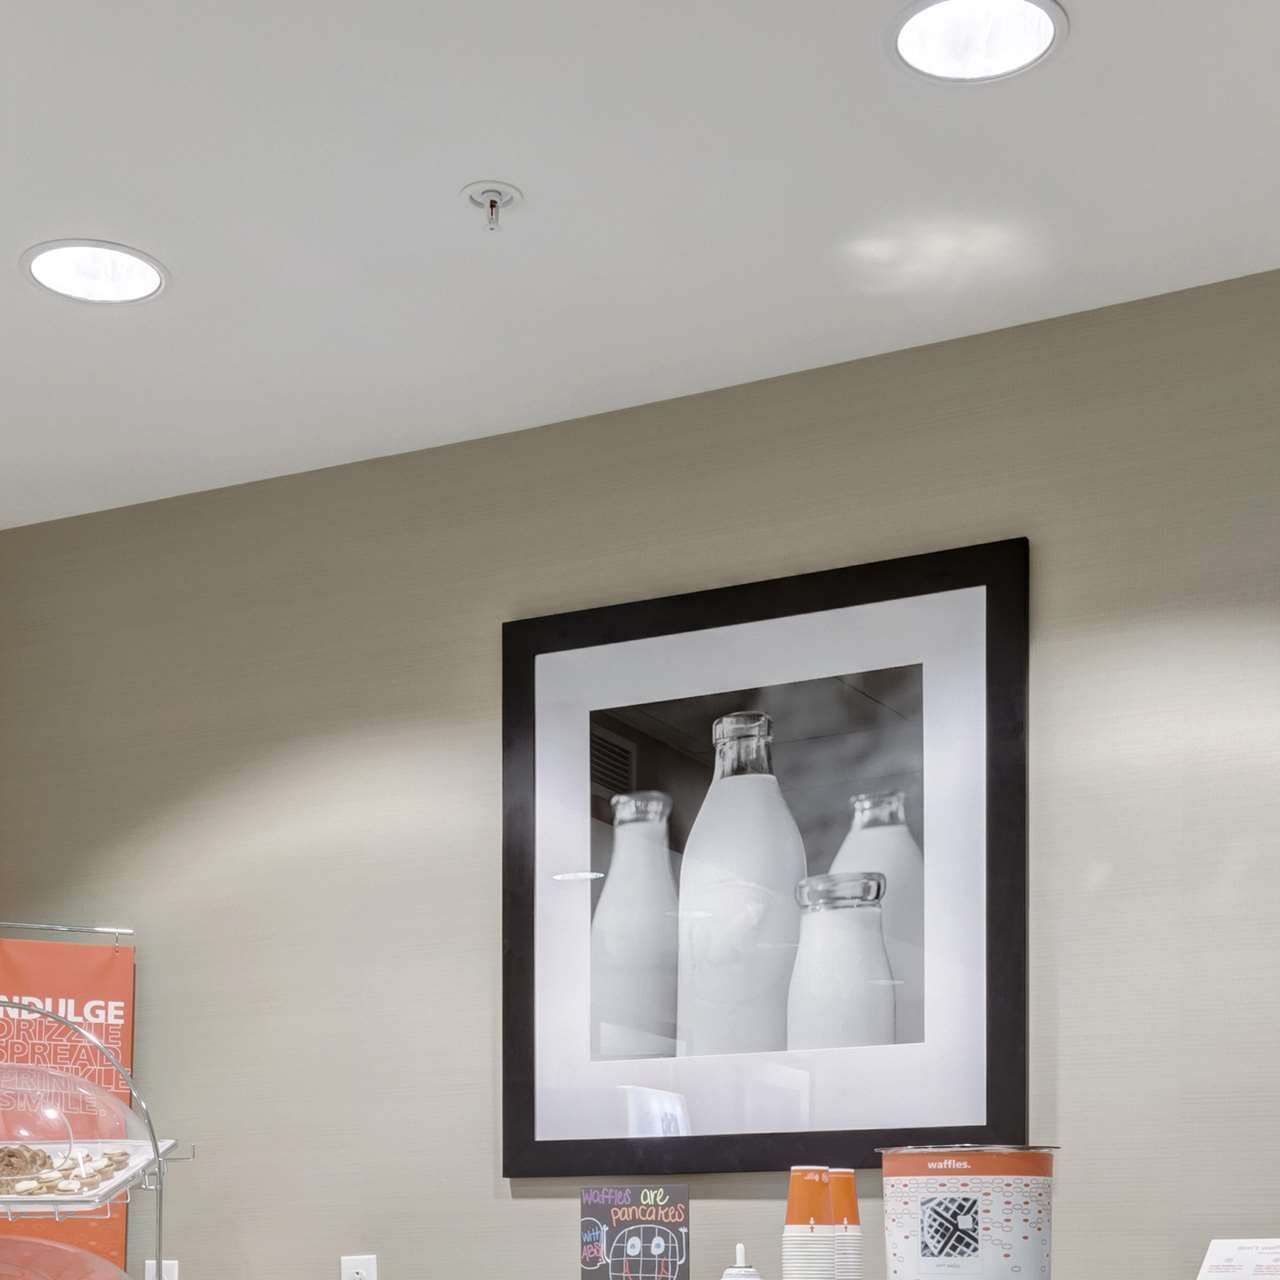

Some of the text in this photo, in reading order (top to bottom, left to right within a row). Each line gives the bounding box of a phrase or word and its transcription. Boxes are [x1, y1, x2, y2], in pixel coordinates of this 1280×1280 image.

[927, 1159, 972, 1169] waffles.
[640, 1187, 670, 1206] are
[610, 1203, 686, 1227] pancakes
